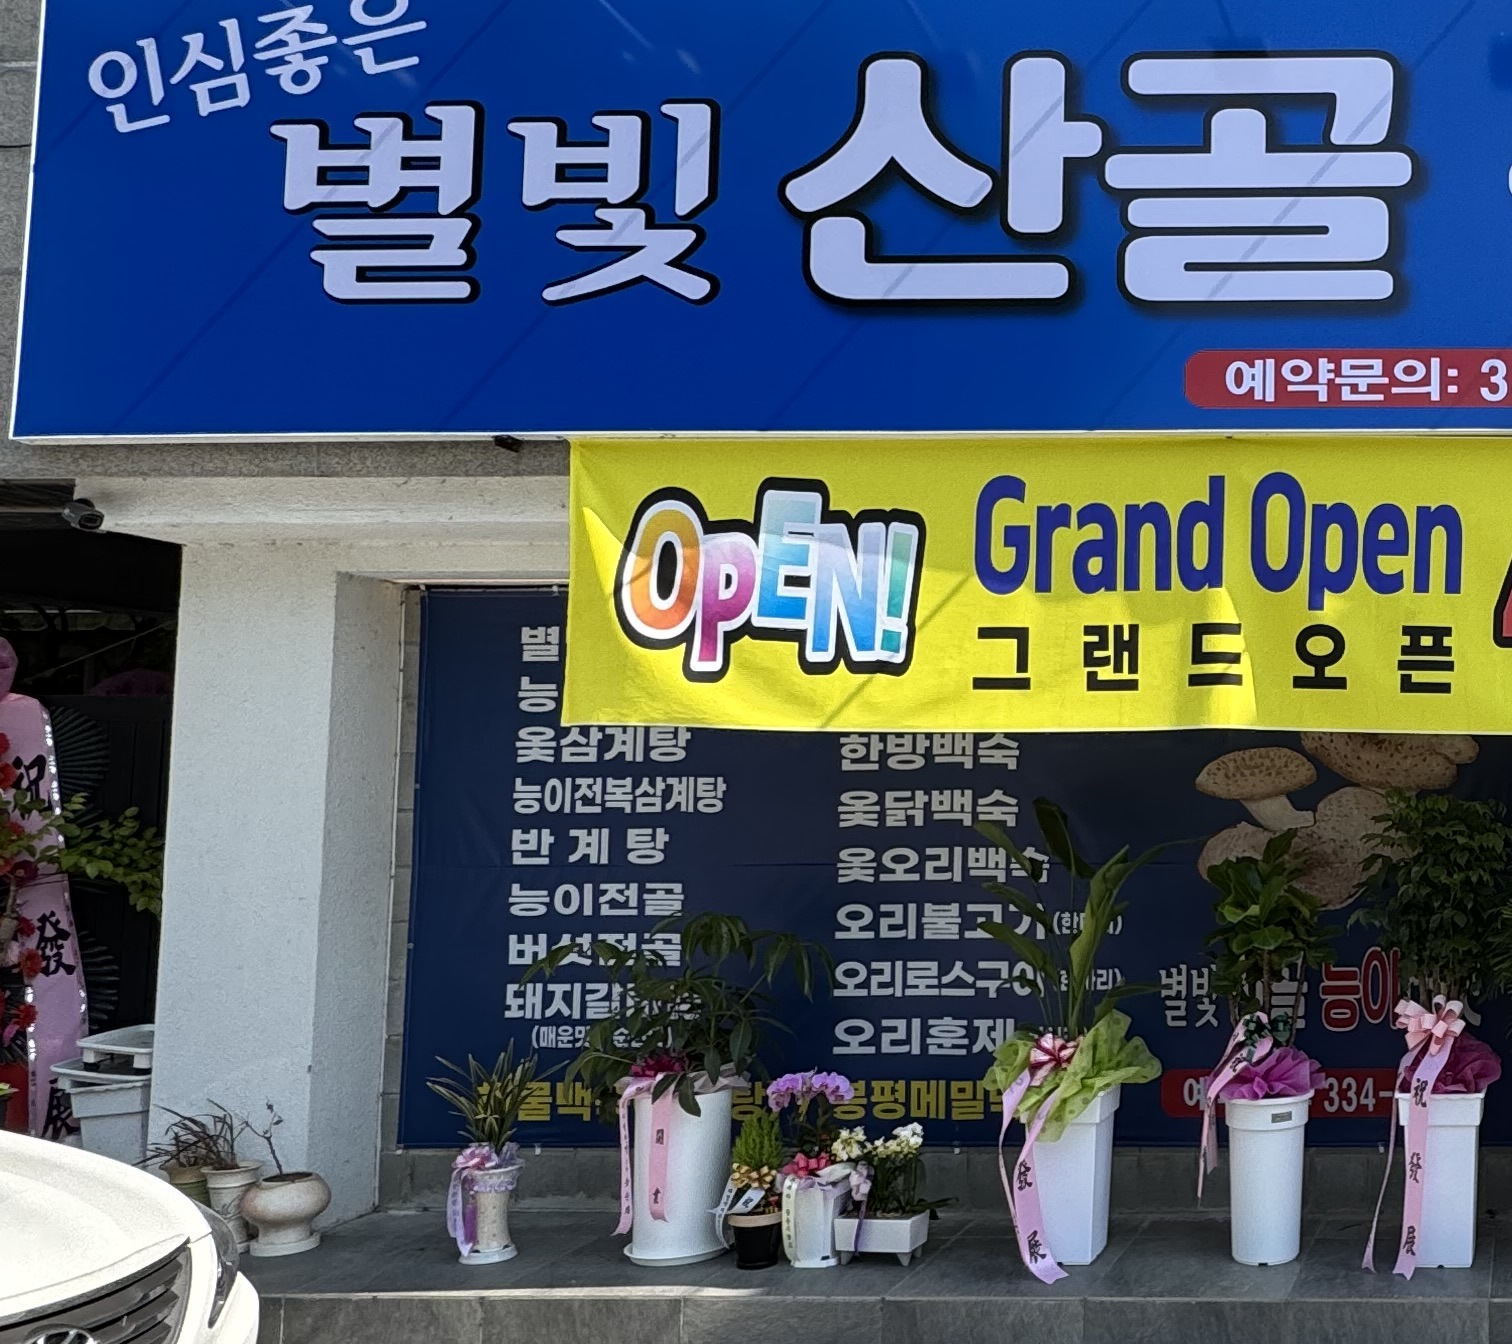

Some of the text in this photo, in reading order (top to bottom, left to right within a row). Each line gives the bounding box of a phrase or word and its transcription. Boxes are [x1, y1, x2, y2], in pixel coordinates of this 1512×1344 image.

[777, 47, 1420, 310] 산골
[1224, 357, 1460, 403] 예약문의:
[973, 471, 1465, 612] Grand Open
[515, 725, 692, 763] 옻삼계탕
[838, 732, 1020, 771] 한방백숙
[512, 776, 727, 814] 능이전복삼계탕
[837, 788, 1020, 828] 옻닭백숙
[508, 882, 685, 918] 능이전골
[832, 1017, 1016, 1056] 오리훈제
